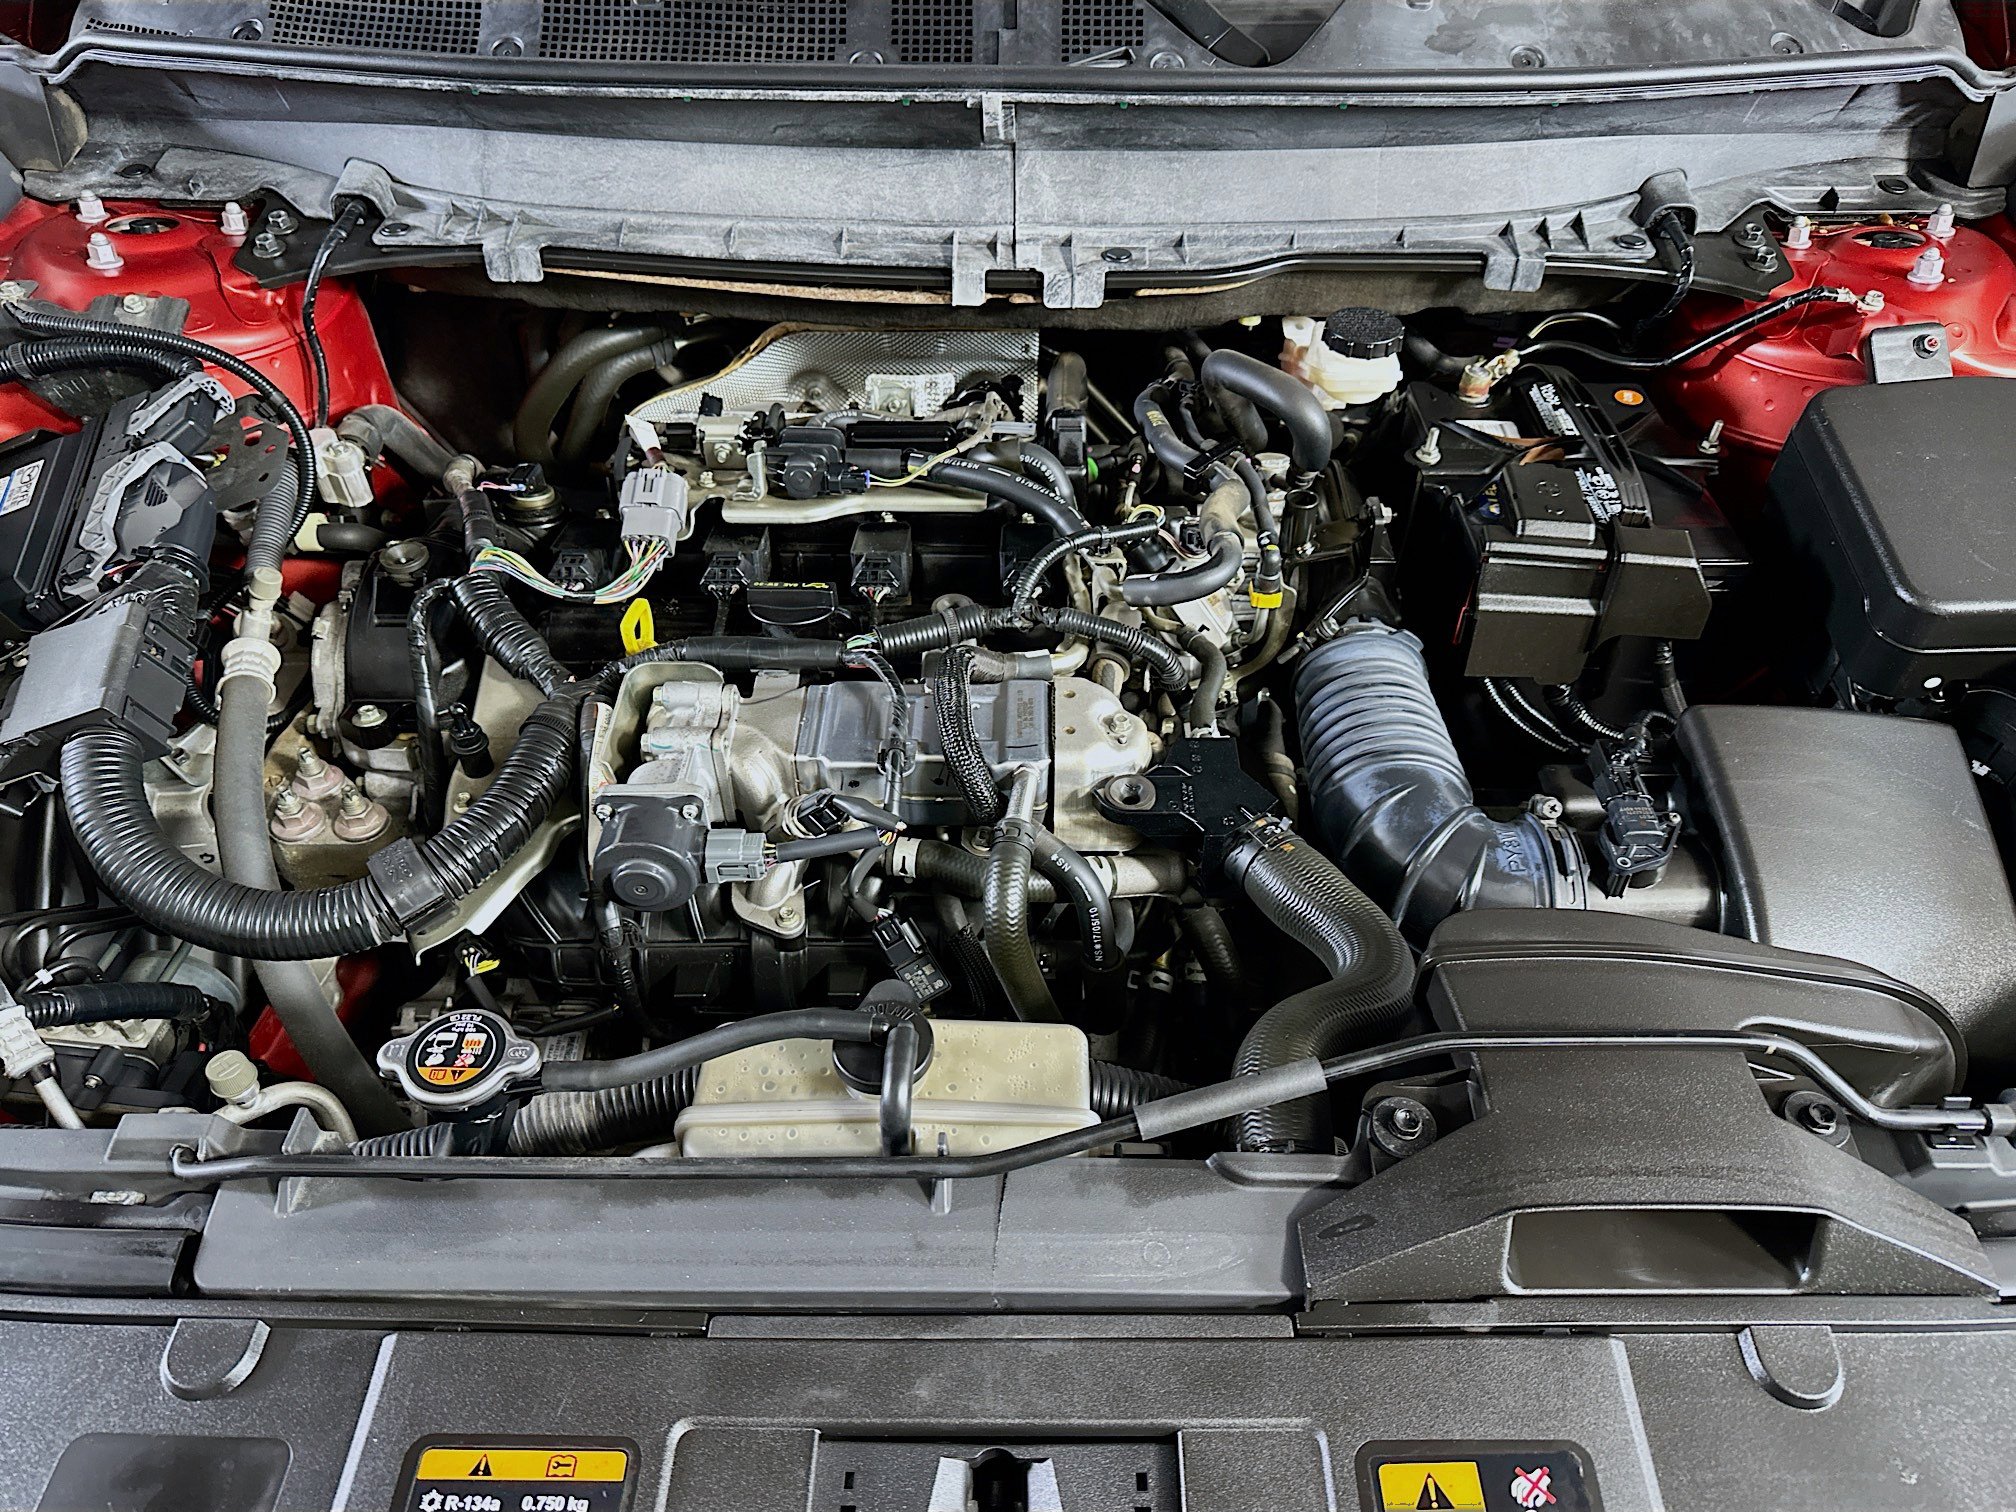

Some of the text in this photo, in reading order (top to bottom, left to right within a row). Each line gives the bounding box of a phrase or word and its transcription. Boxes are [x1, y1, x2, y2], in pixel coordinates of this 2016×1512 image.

[444, 1494, 589, 1512] R-134a 0.750 kg
